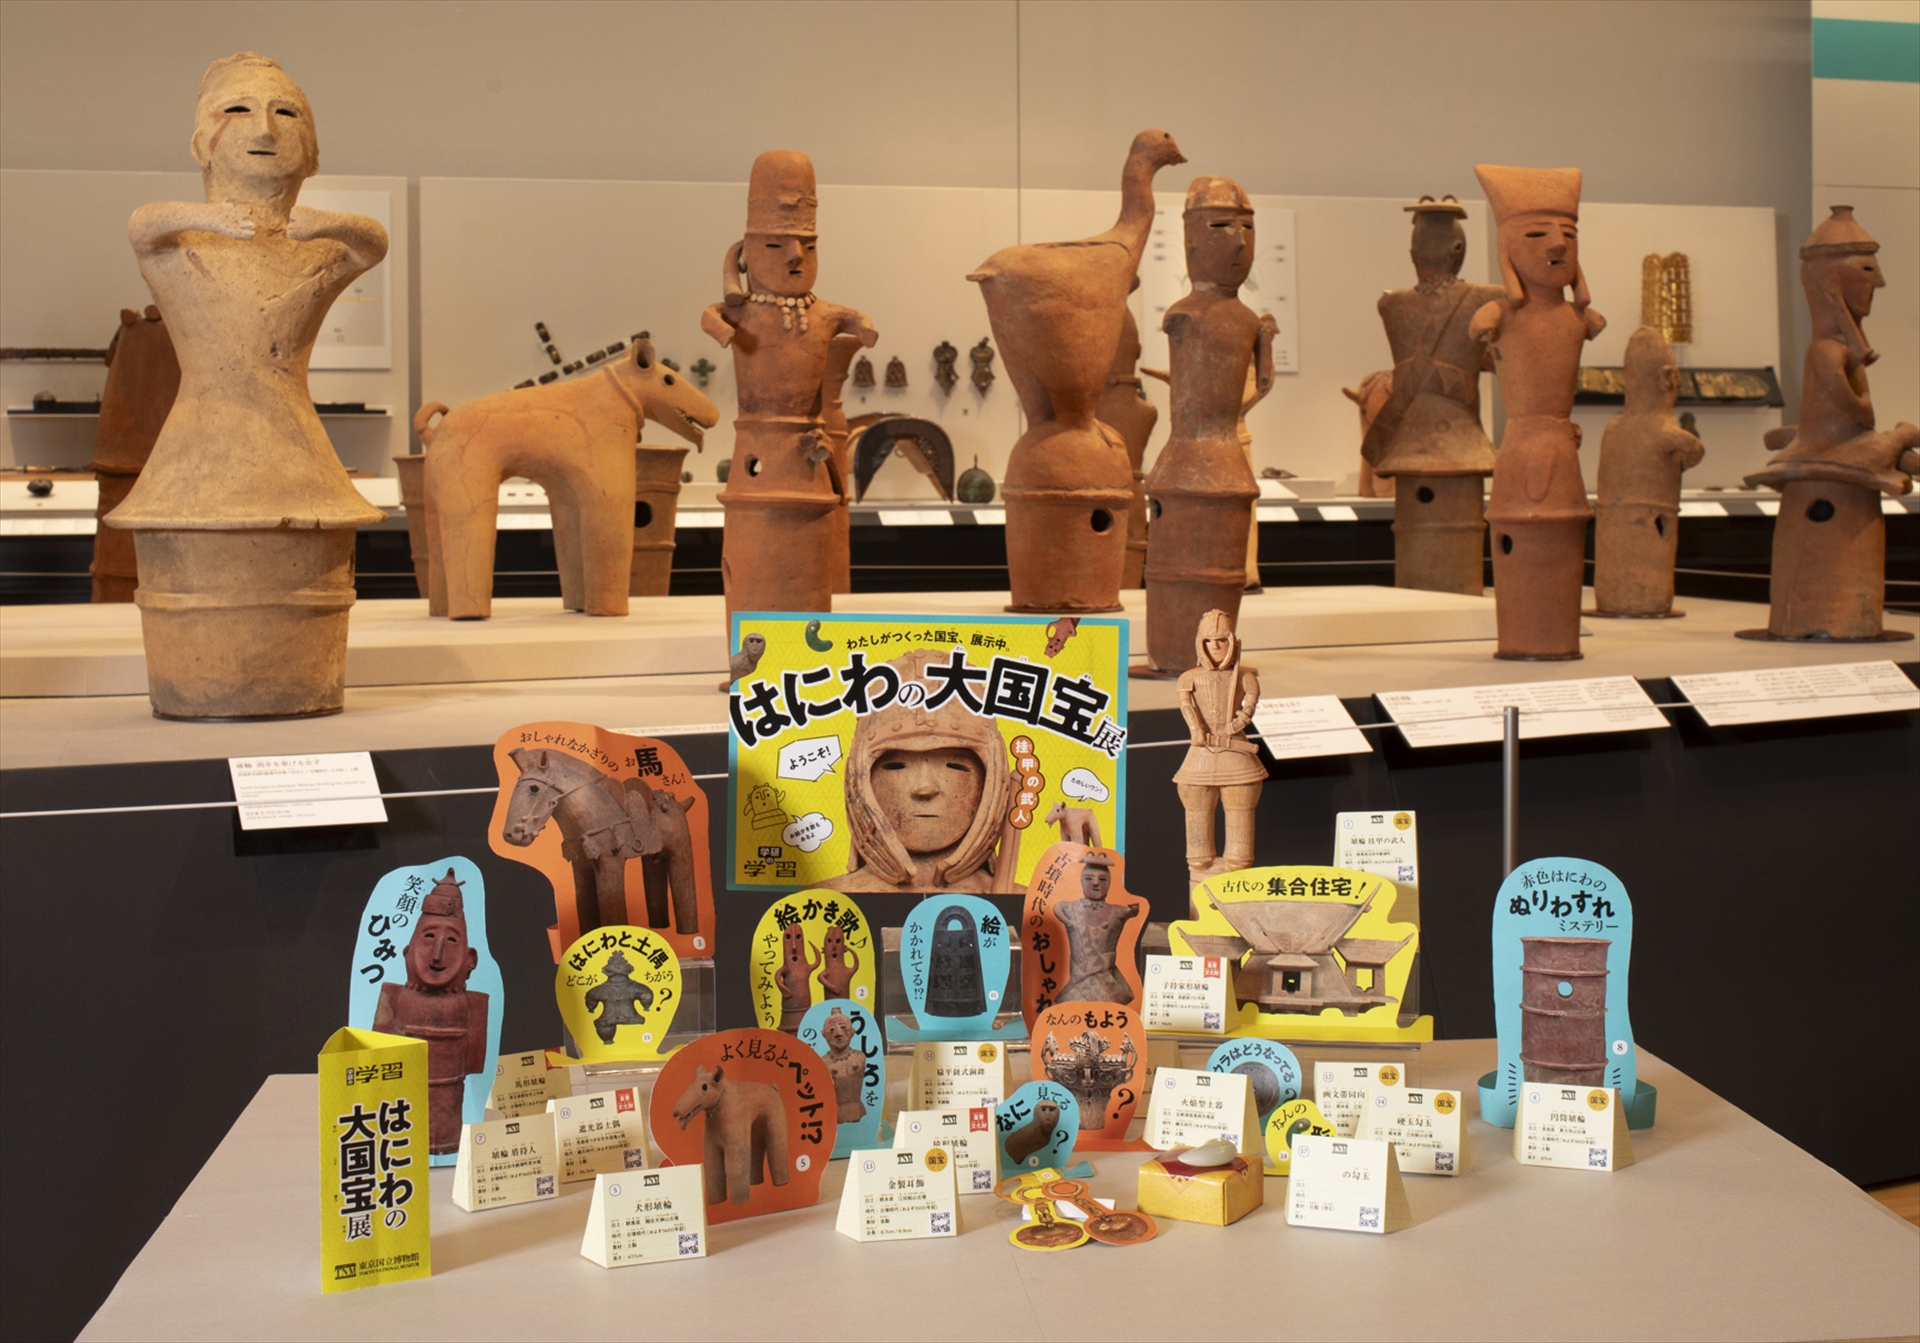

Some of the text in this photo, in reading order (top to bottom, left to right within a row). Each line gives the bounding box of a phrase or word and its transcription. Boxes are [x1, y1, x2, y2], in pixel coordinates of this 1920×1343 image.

[847, 629, 1010, 652] わたしがつくった国宝、展示中。
[730, 653, 1128, 757] はにわの大国宝展
[519, 731, 686, 787] おしゃれなかざりの お馬さん！
[789, 746, 831, 770] ようこそ！
[1014, 740, 1039, 823] 挂甲の武人
[1070, 777, 1103, 793] たのしいワン！
[744, 860, 796, 877] 学習
[1520, 869, 1607, 892] 赤色はにわの
[391, 875, 425, 928] 笑顔の
[1222, 877, 1366, 899] 古代の集合住宅！
[1509, 889, 1615, 919] ぬりわすれ
[774, 899, 860, 940] 絵かき歌
[980, 914, 1001, 949] 絵が
[1558, 920, 1619, 933] ミステリー
[360, 914, 397, 984] ひみつ
[568, 931, 669, 971] はにわと土偶
[909, 921, 924, 1000] かかれてる！？
[566, 970, 674, 1012] どこが ちがう ？
[757, 933, 778, 1027] やってみよう
[850, 1011, 880, 1107] うしろを
[1617, 1043, 1623, 1051] 8
[356, 1062, 403, 1084] 学習
[1046, 1010, 1135, 1119] なんのもよう ？
[1271, 1103, 1307, 1131] なんの
[1437, 1099, 1453, 1108] 国宝
[1053, 1129, 1069, 1155] ？
[339, 1105, 377, 1240] 大国宝展
[379, 1099, 413, 1229] はにわの
[800, 1159, 806, 1167] 5
[928, 1155, 945, 1165] 国宝
[888, 1179, 925, 1189] 金製耳飾
[1342, 1171, 1370, 1181] の勾玉
[635, 1200, 672, 1212] 犬形埴輪
[359, 1252, 420, 1270] 東京国立博物館
